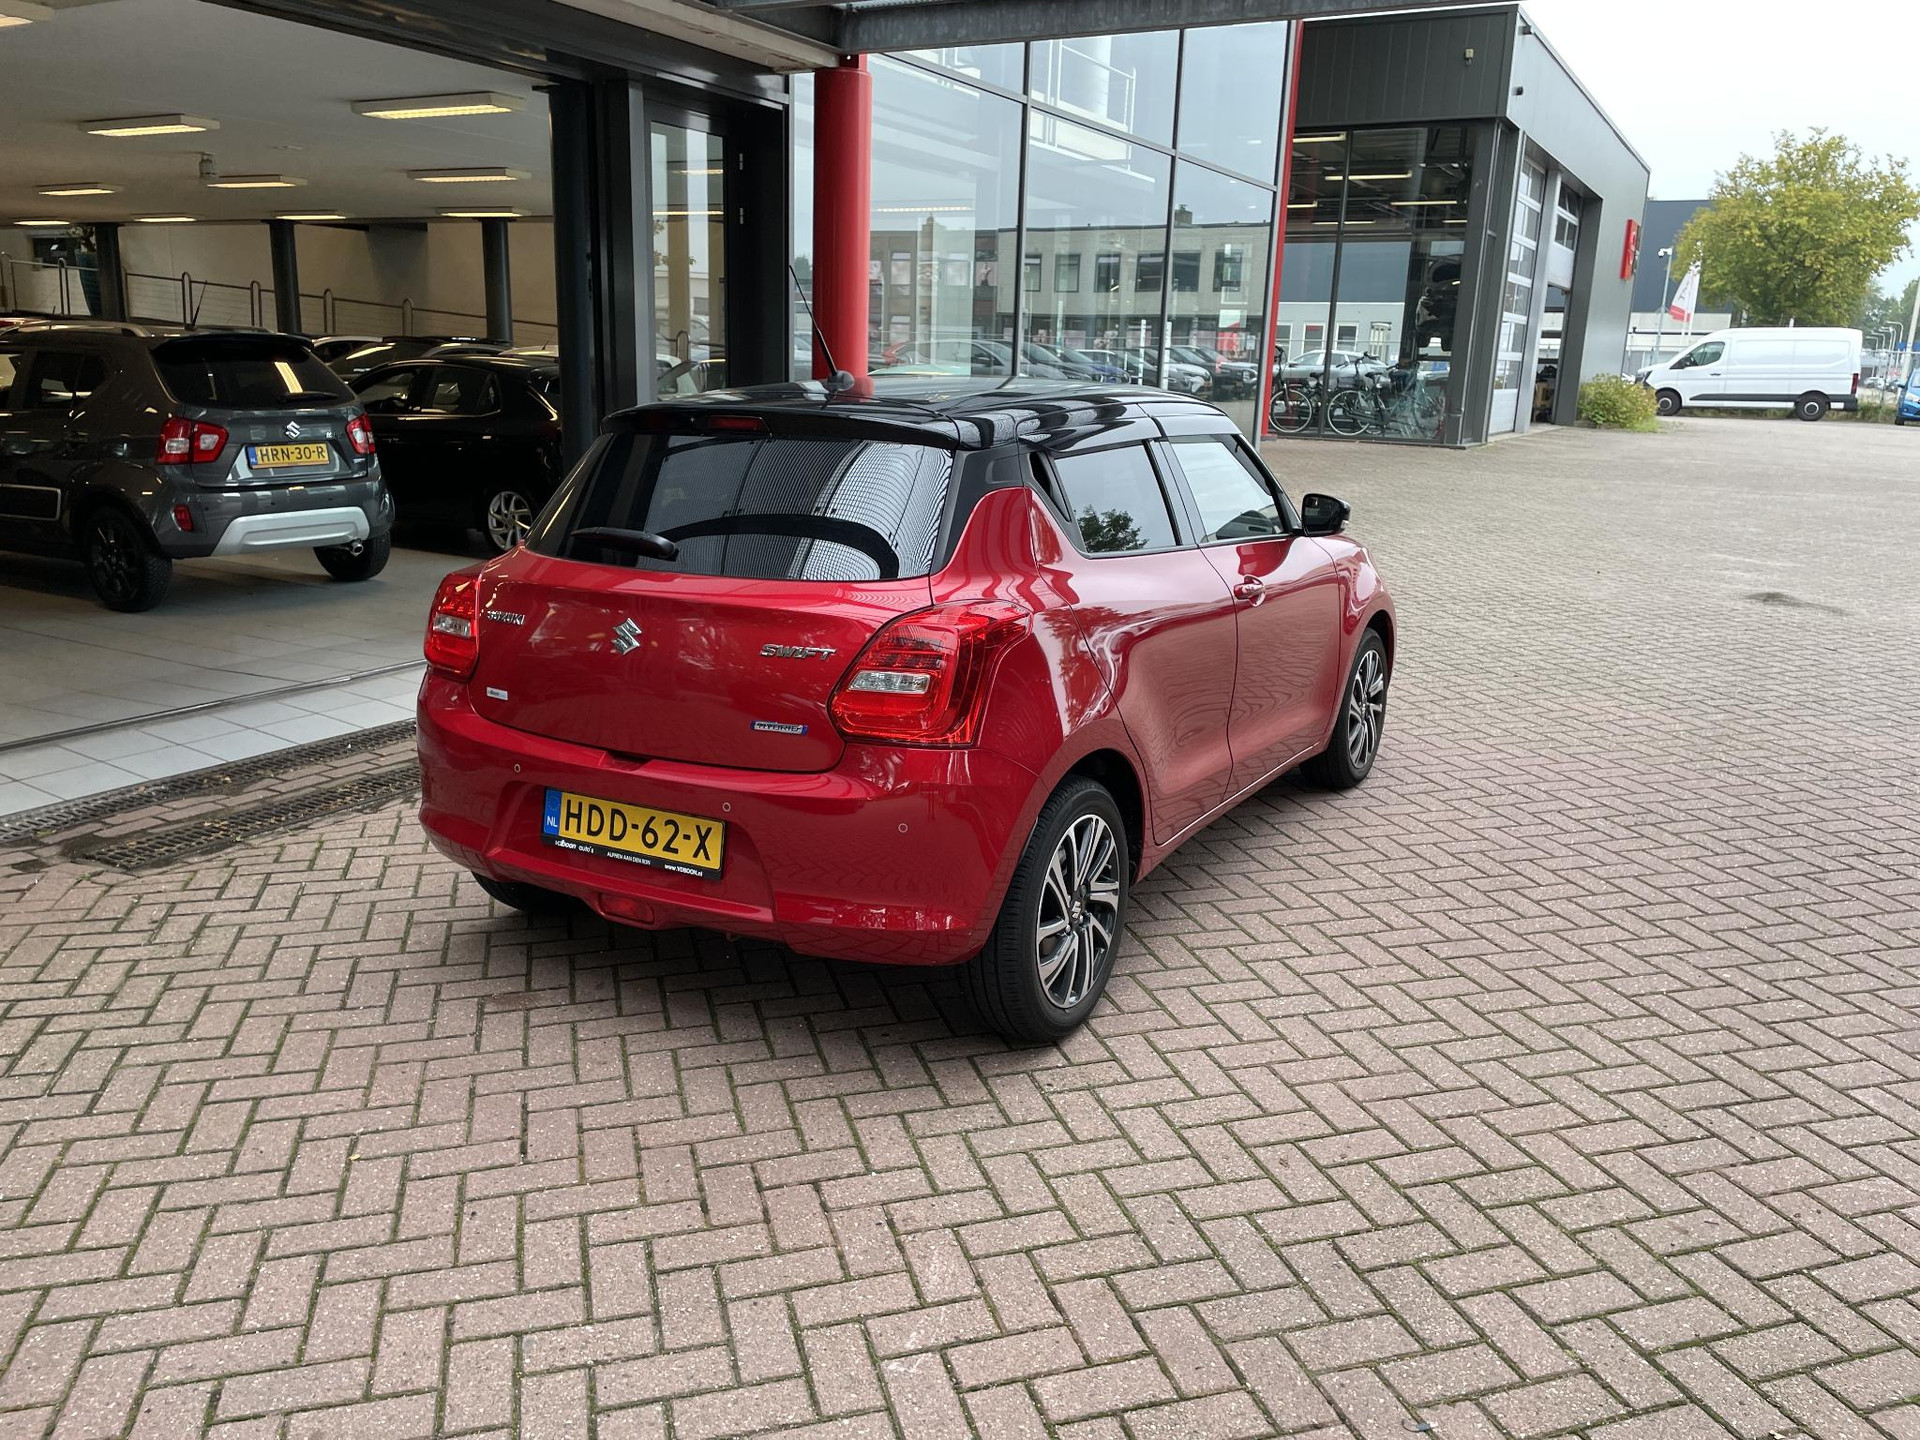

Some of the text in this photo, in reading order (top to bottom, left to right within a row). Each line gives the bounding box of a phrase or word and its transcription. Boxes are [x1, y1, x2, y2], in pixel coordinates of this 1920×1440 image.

[260, 445, 326, 463] HRN-30-R
[487, 610, 526, 625] SUZUKI
[760, 643, 837, 661] SWIFT
[546, 815, 558, 828] NL
[564, 799, 713, 861] HDD-62-X
